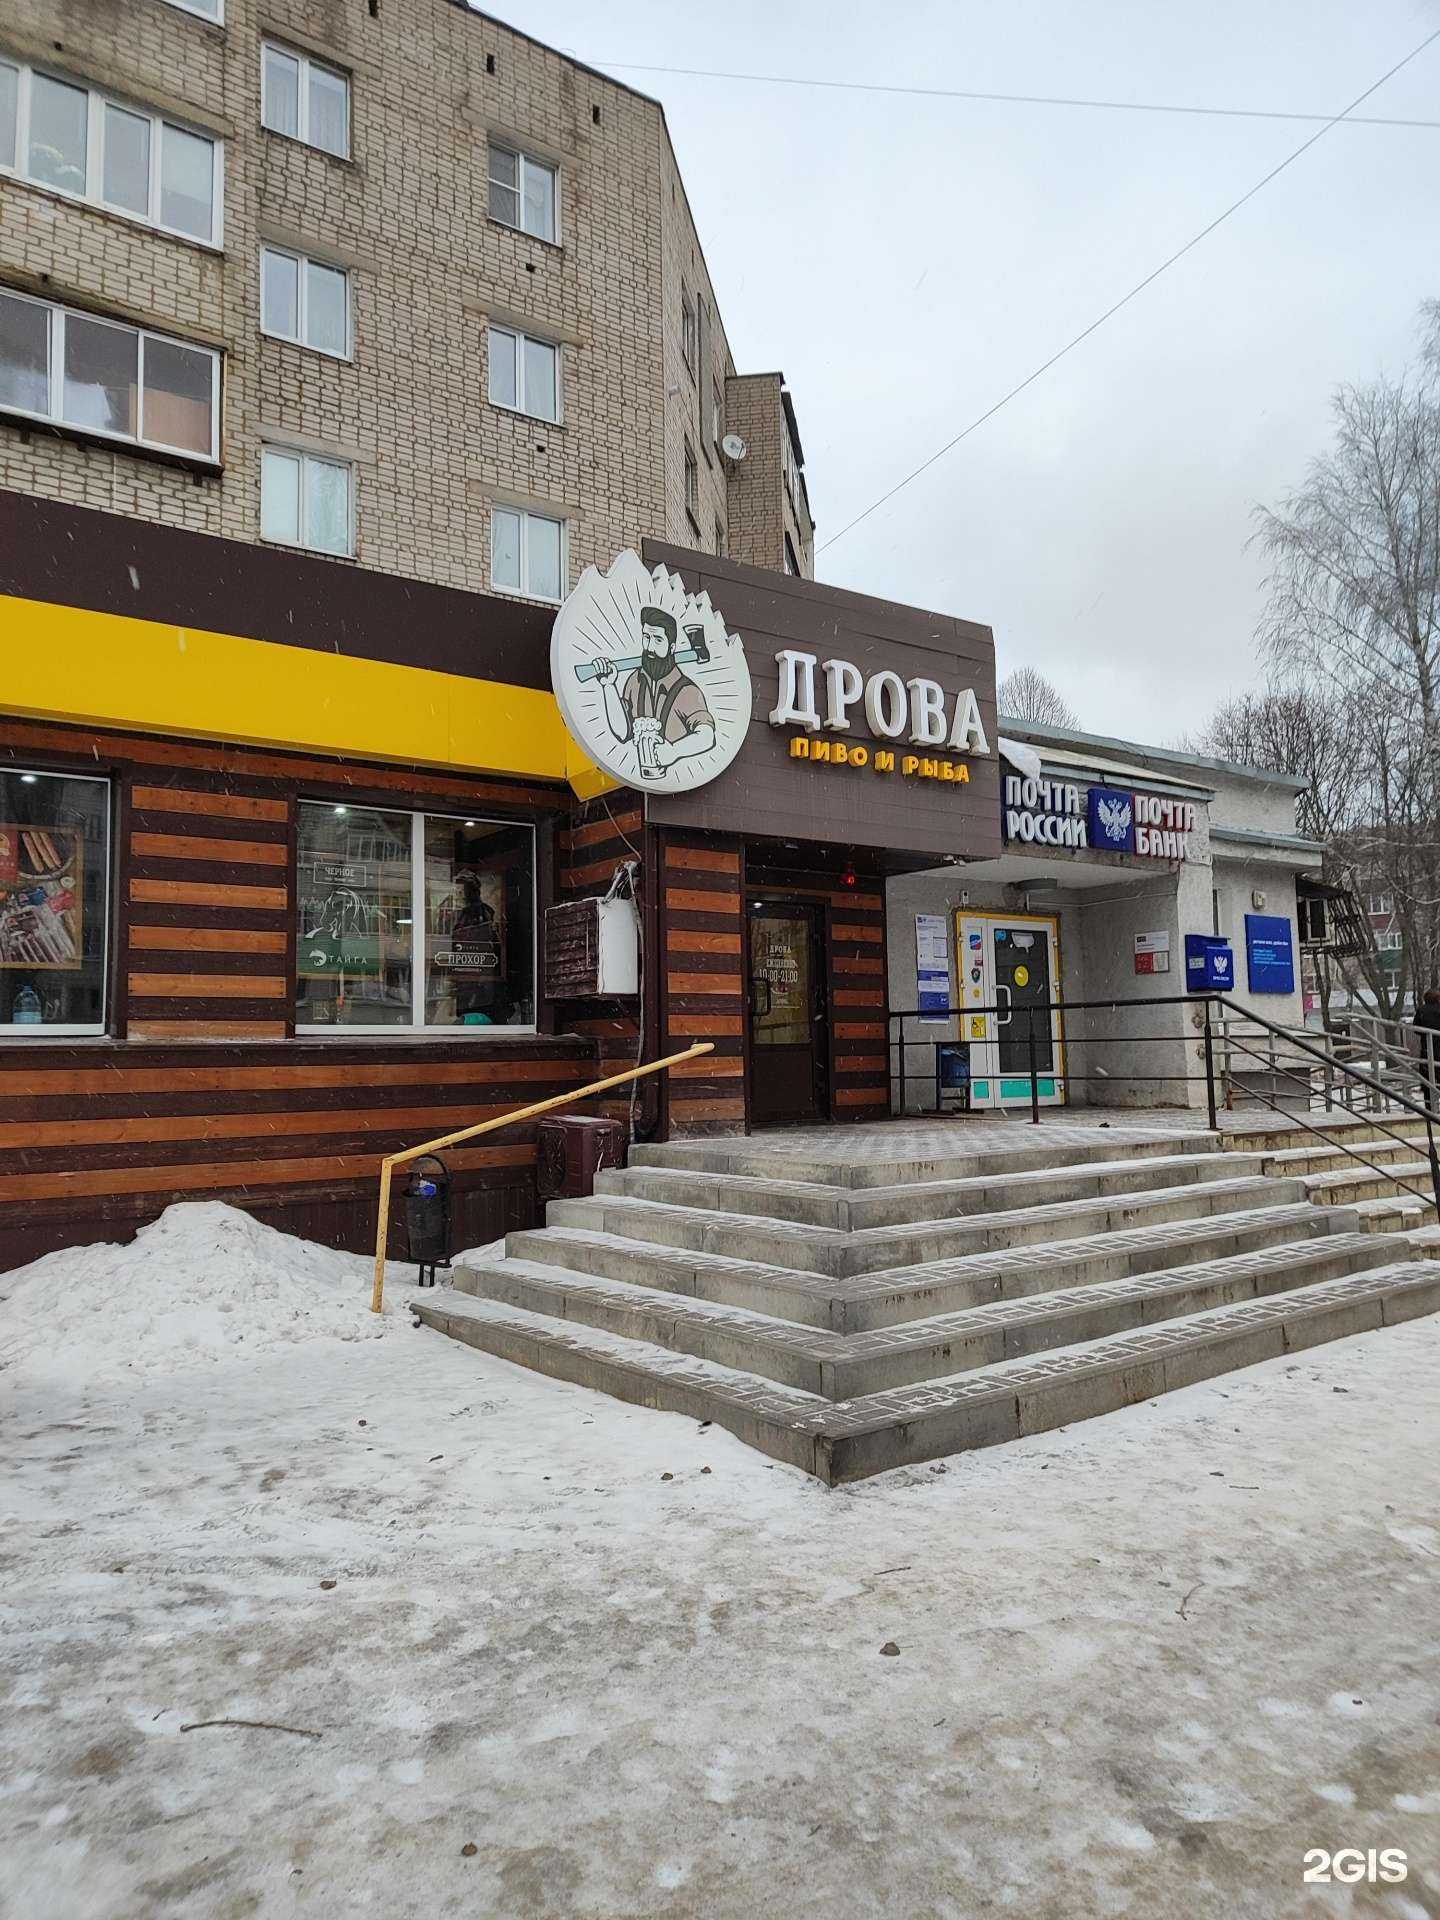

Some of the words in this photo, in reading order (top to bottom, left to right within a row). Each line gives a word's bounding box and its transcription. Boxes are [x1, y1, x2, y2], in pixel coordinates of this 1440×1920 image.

[769, 650, 991, 757] ДРОВА
[790, 737, 868, 767] ПИВО
[874, 750, 895, 772] И
[902, 755, 970, 783] РЫБА
[1006, 775, 1080, 814] ПОЧТА
[1134, 794, 1197, 832] ПОЧТА
[1006, 810, 1087, 848] РОССИИ
[1134, 827, 1192, 860] БАНК
[328, 955, 368, 965] ТАЙГА
[447, 954, 486, 965] ПРОХОР
